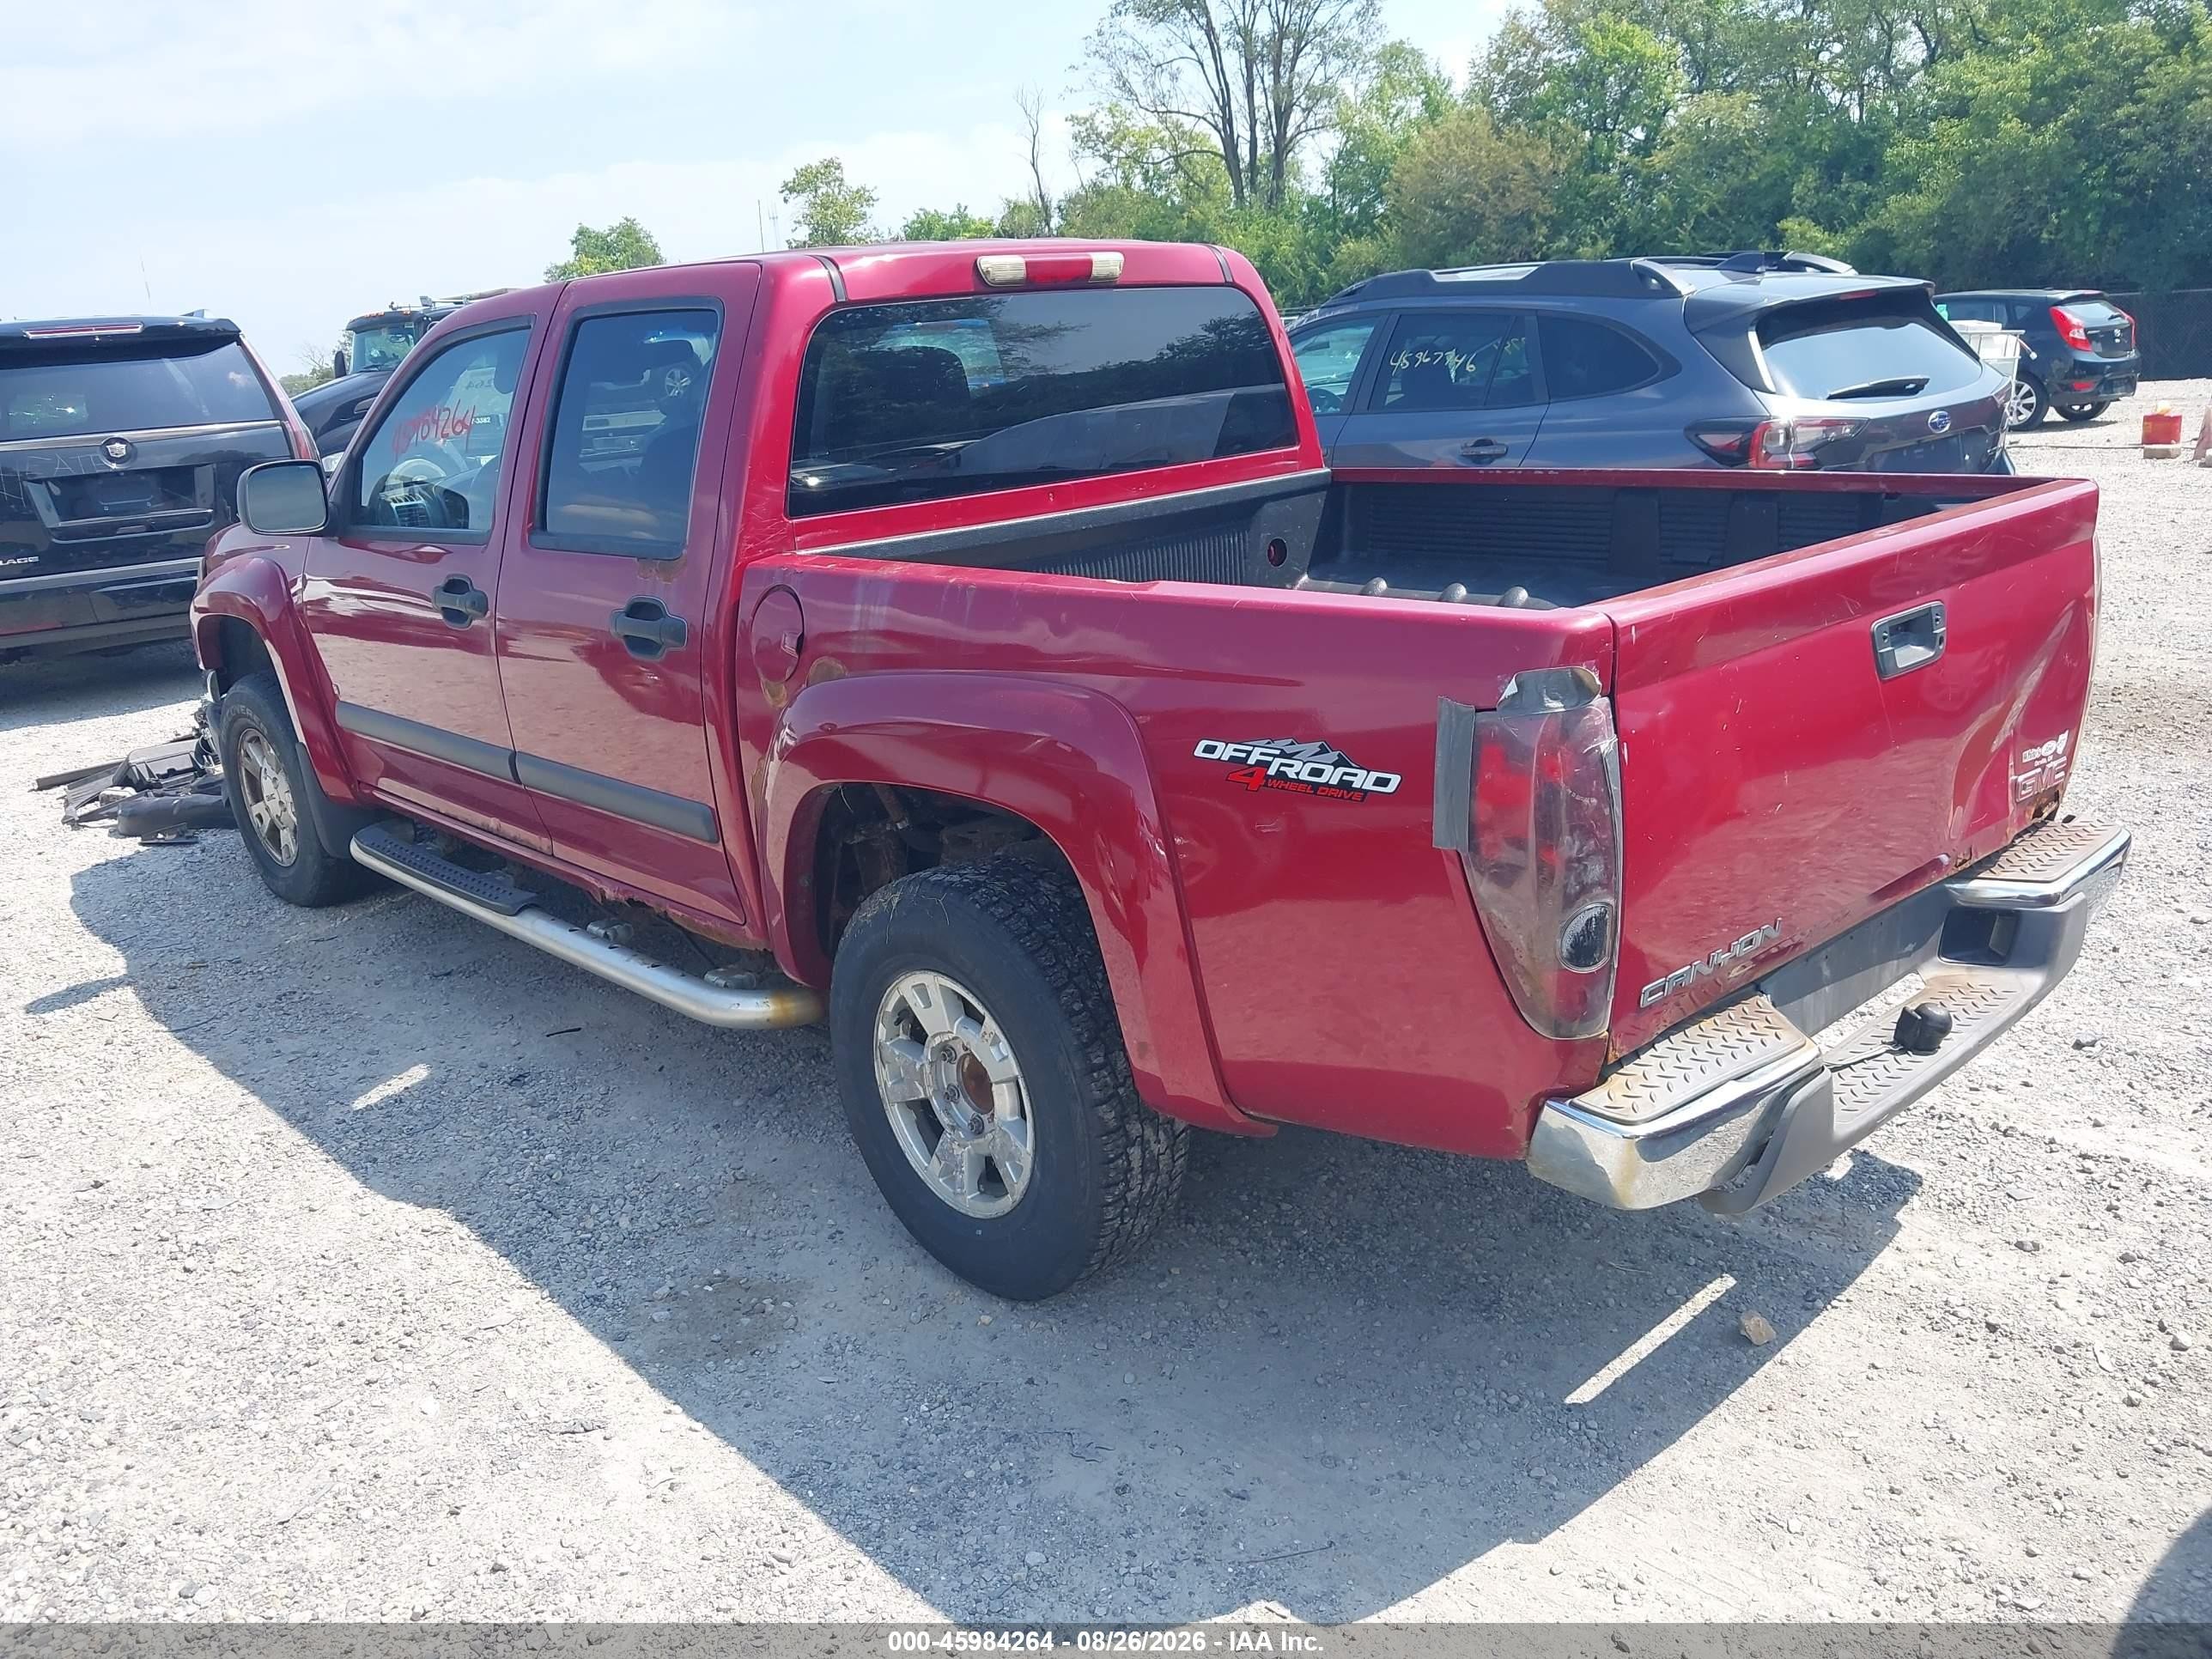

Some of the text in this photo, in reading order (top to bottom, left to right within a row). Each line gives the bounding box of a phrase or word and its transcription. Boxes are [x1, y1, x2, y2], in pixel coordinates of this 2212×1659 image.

[1227, 766, 1364, 801] 4 WHEEL DRIVE
[1639, 917, 1784, 1009] CANYON
